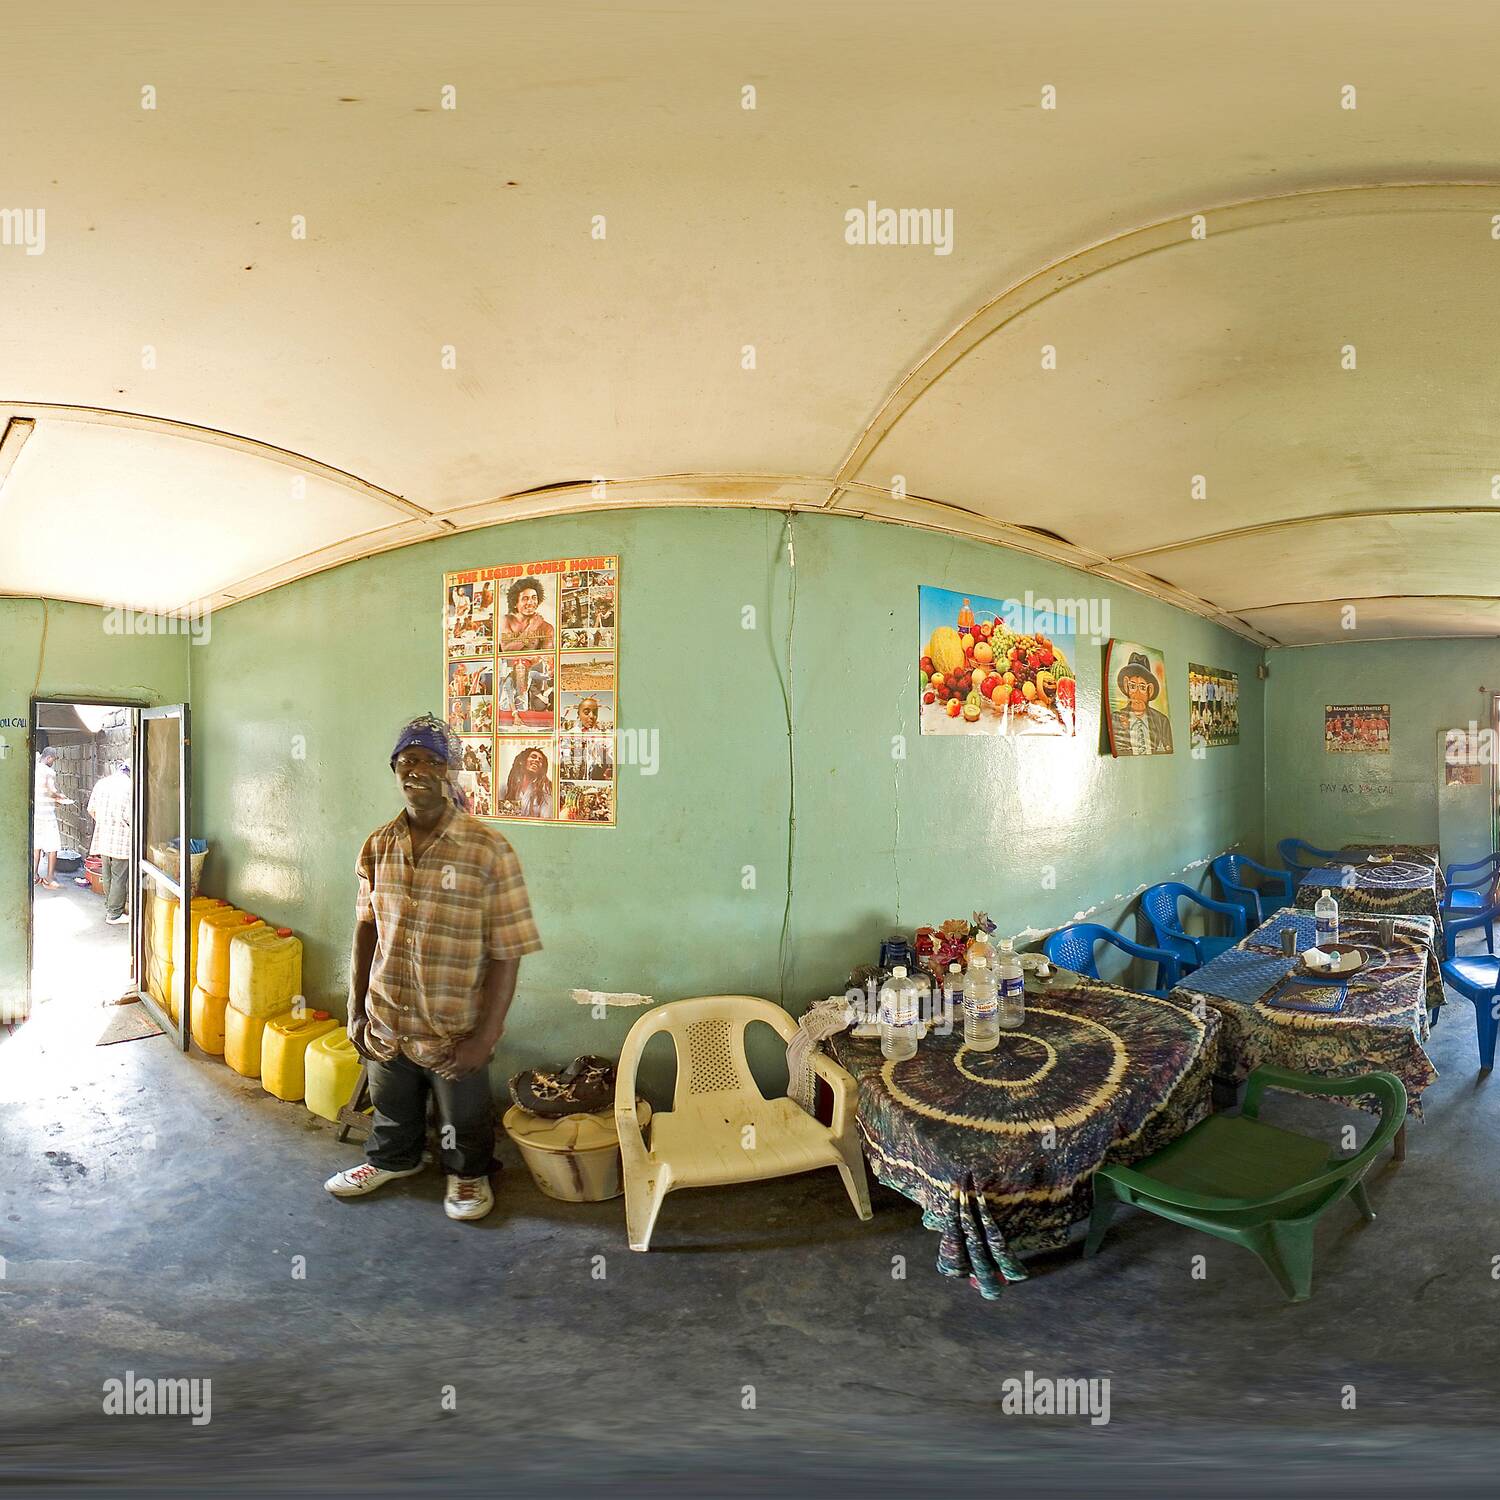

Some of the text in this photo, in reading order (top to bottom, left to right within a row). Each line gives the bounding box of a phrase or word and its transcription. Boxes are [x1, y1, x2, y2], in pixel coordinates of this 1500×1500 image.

[456, 558, 606, 585] THE LEGEND COMES HOME
[1342, 784, 1354, 793] AS
